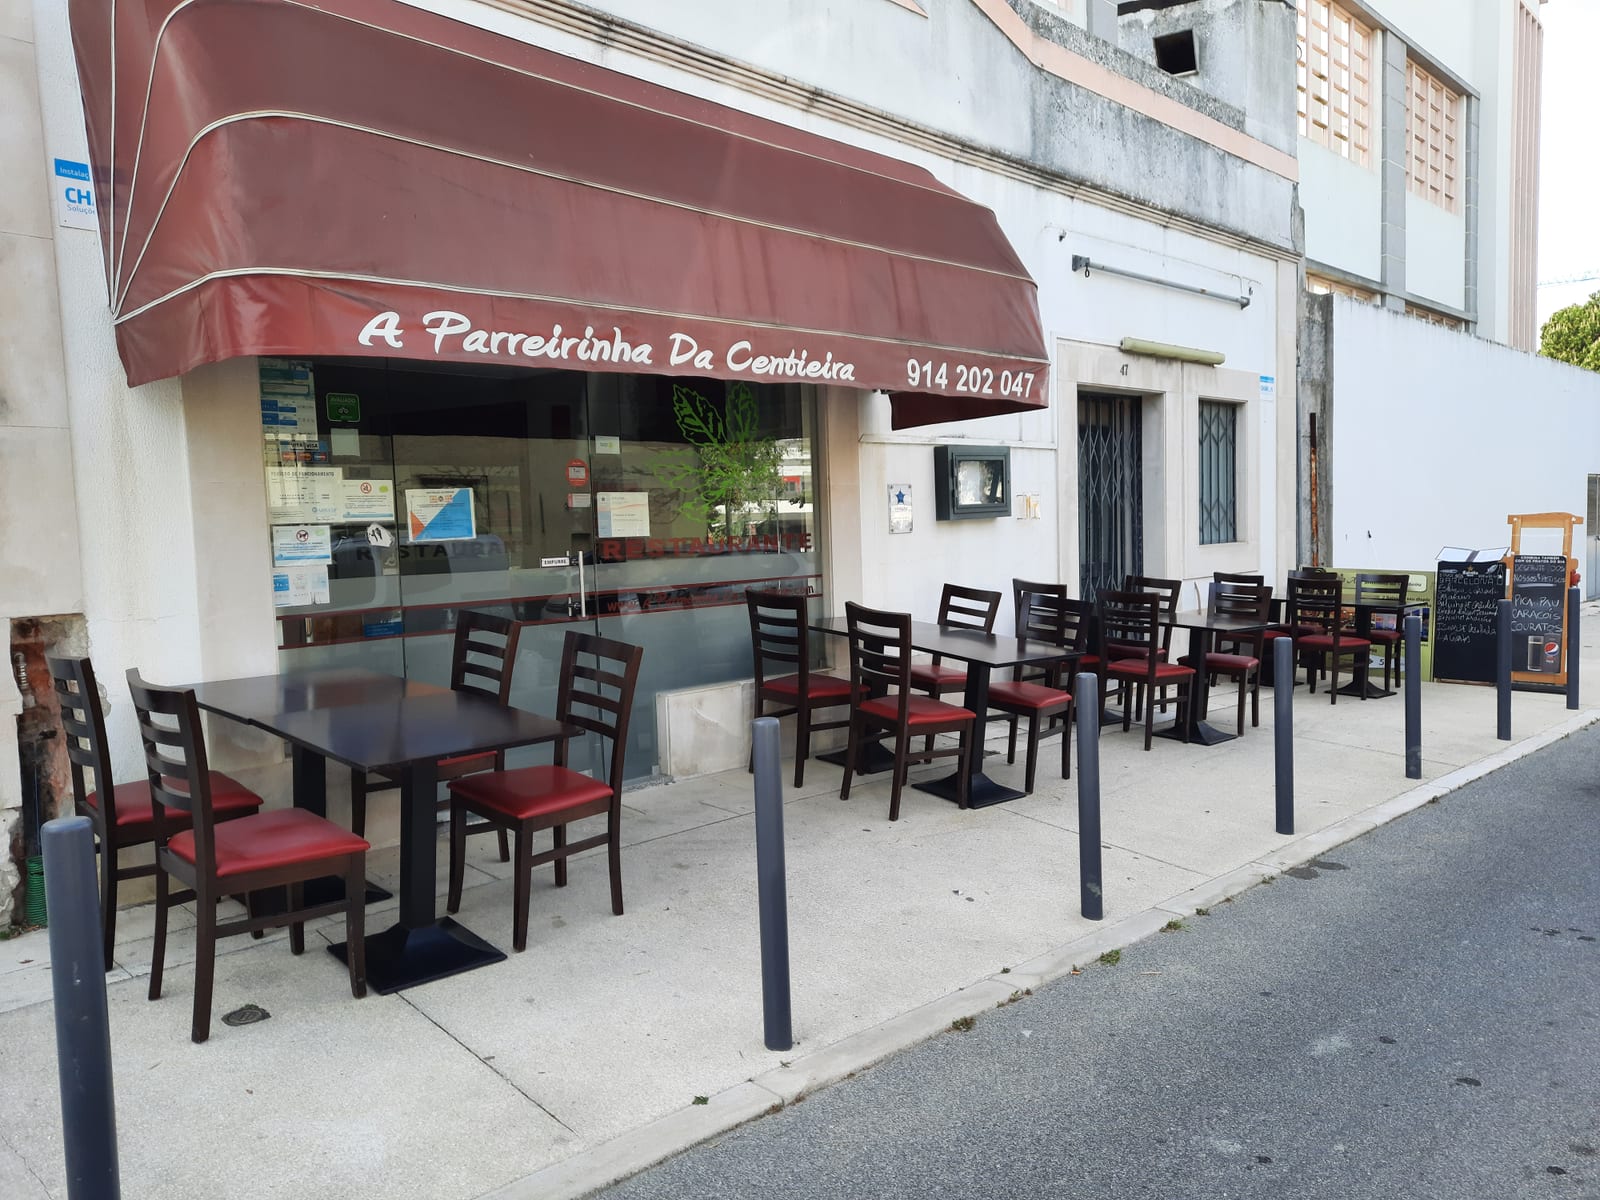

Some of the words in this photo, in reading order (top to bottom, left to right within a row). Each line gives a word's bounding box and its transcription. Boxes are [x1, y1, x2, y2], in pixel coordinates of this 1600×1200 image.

[65, 187, 95, 206] CH
[358, 311, 403, 348] A
[422, 310, 653, 364] Parreirinha
[669, 332, 713, 370] Da
[726, 339, 855, 381] Centieira
[907, 358, 948, 389] 914
[956, 364, 994, 394] 202
[1000, 370, 1035, 398] 047
[1119, 363, 1129, 377] 47
[602, 533, 812, 561] RESTAURANTE
